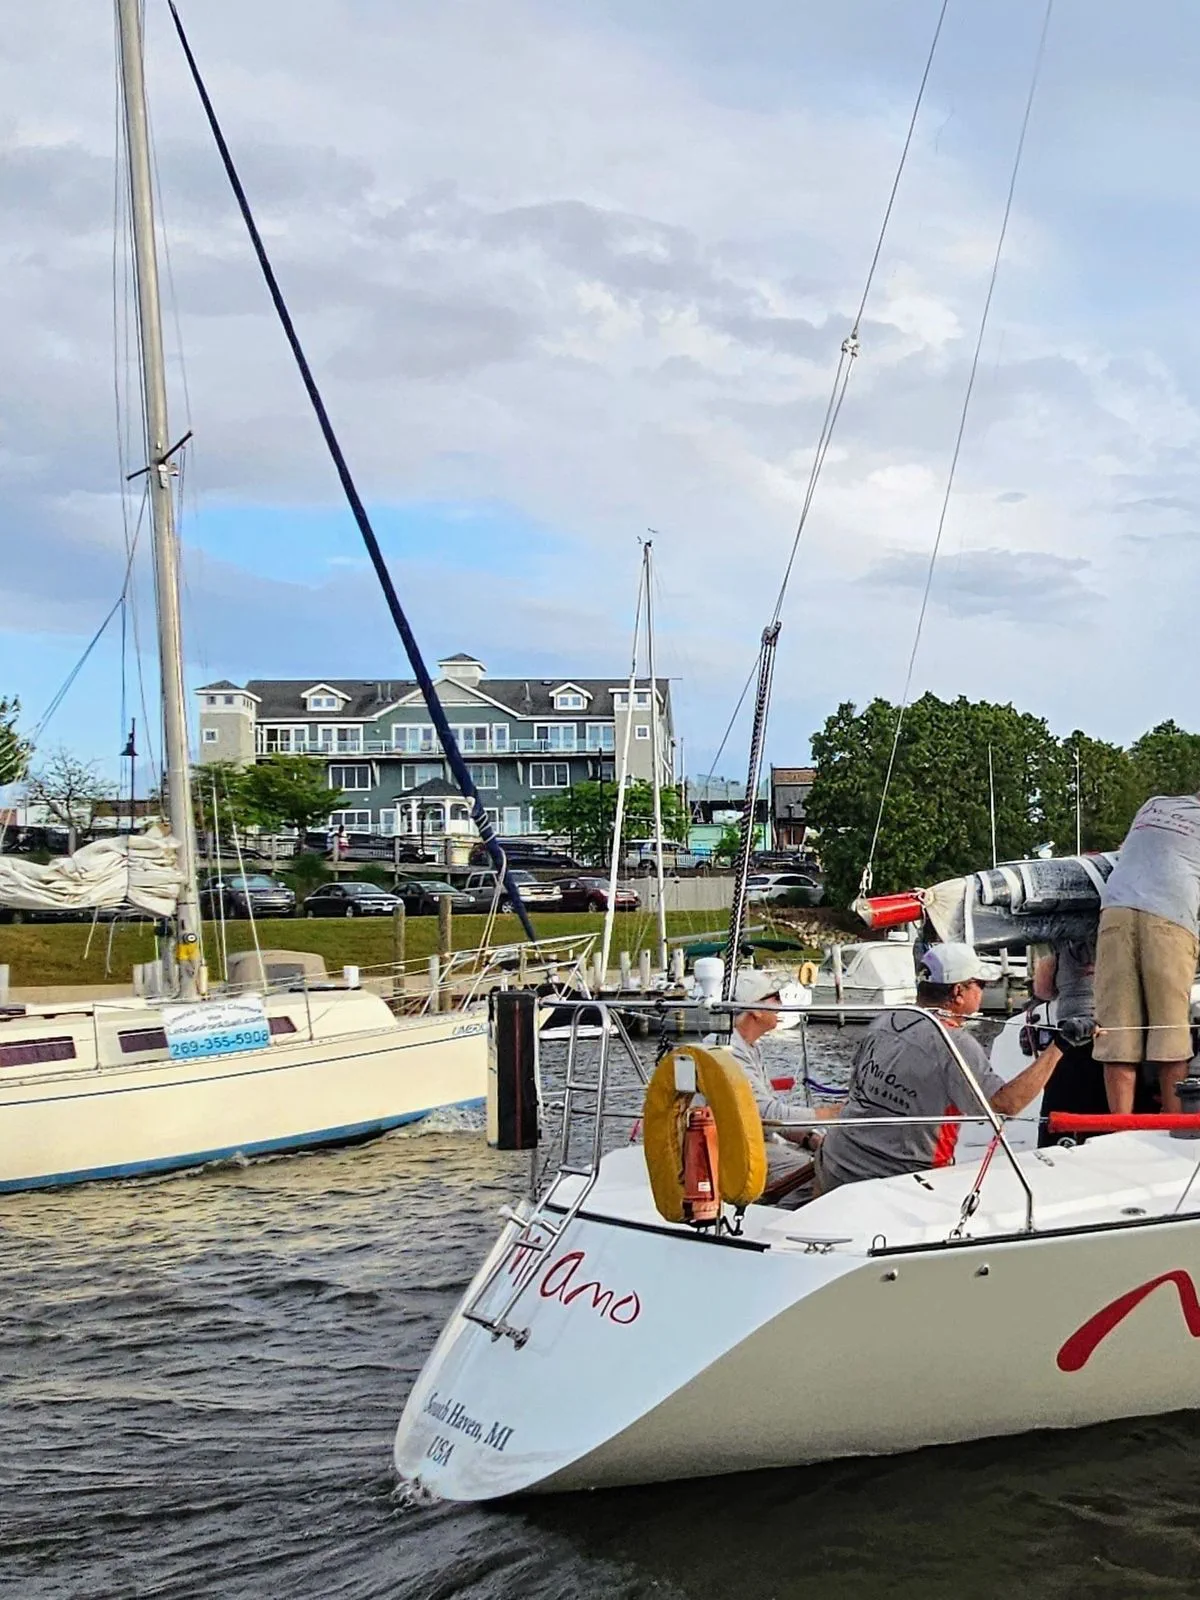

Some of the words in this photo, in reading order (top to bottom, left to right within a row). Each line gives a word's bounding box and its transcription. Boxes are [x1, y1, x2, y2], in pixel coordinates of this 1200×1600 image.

[170, 1029, 270, 1057] 269-355-5908
[426, 1435, 455, 1467] USA
[483, 1421, 515, 1452] MI
